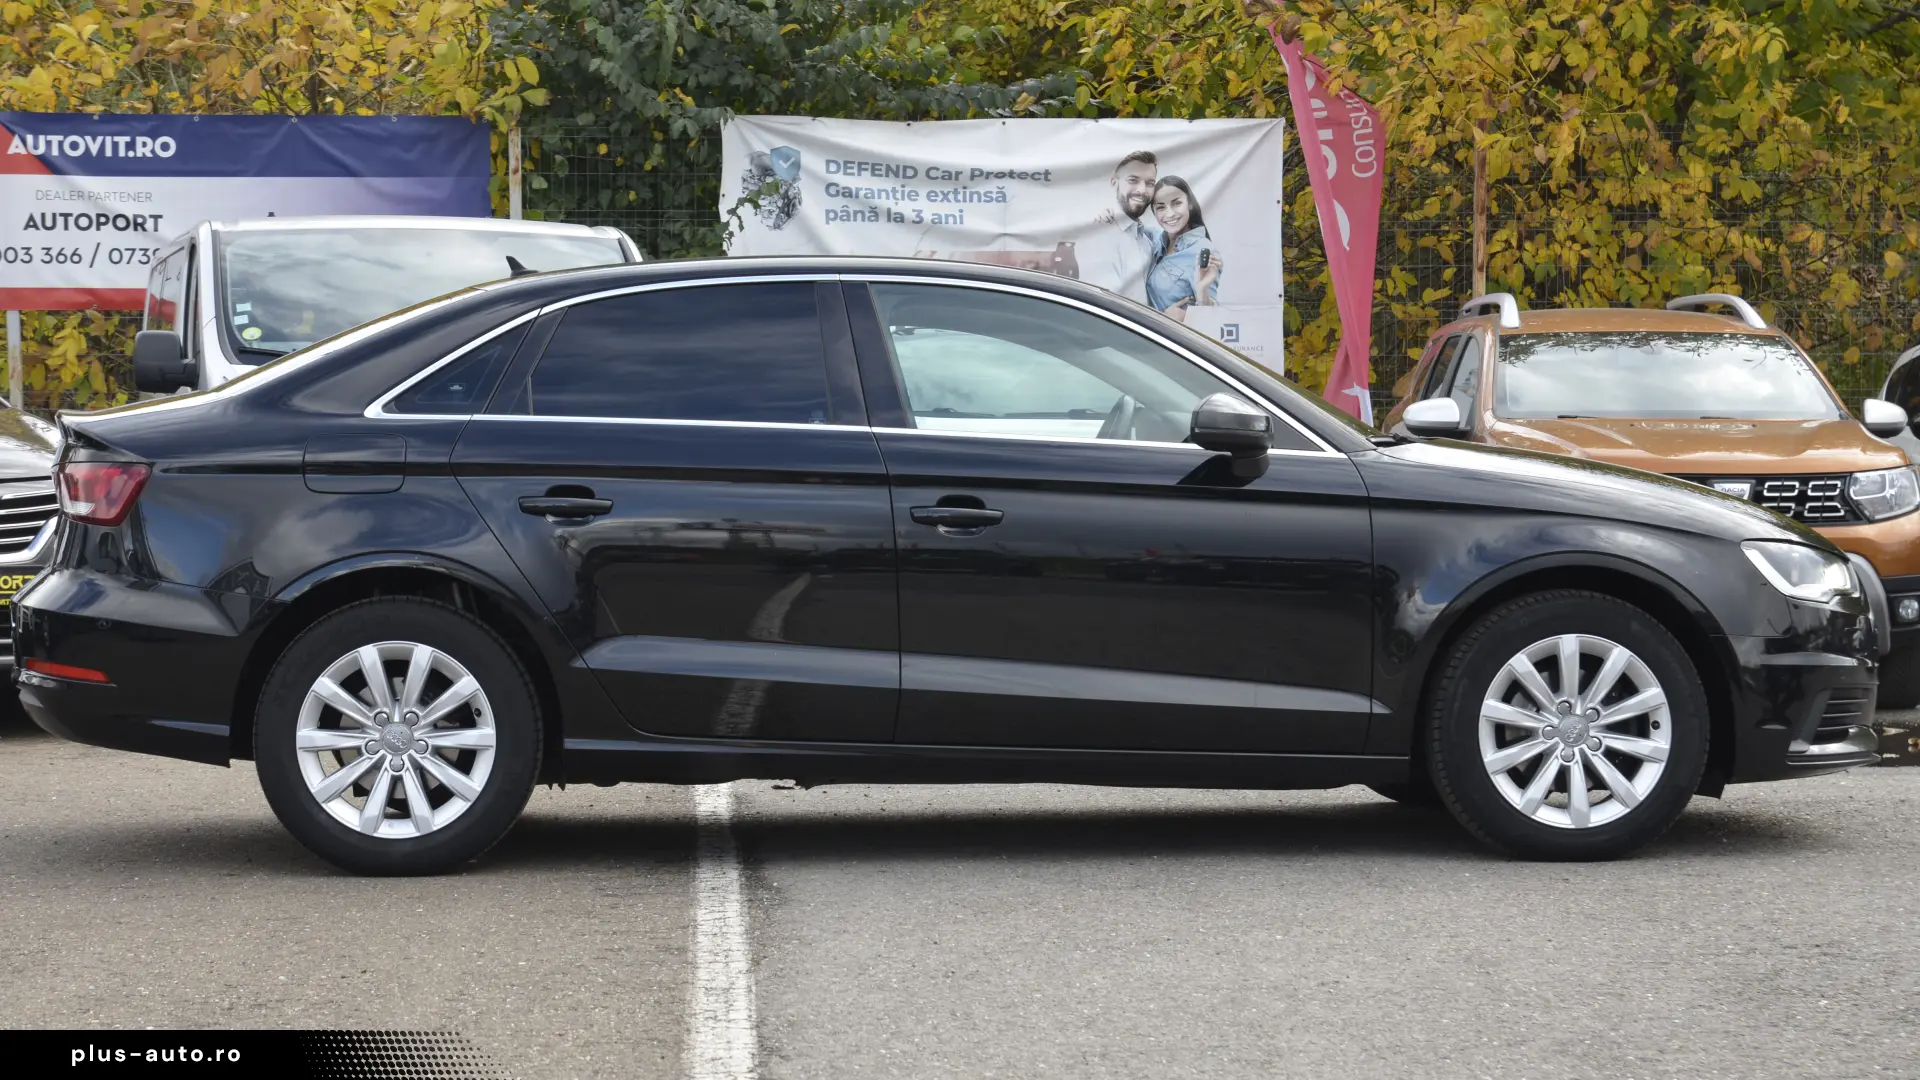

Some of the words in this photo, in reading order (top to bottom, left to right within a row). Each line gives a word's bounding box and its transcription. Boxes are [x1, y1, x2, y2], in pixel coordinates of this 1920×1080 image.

[6, 133, 177, 158] AUTOVIT.RO
[824, 158, 919, 180] DEFEND
[925, 166, 963, 181] Car
[969, 167, 1052, 182] Protect
[35, 189, 86, 202] DEALER
[88, 191, 153, 203] PARTENER
[926, 186, 1007, 204] extinsă
[23, 212, 164, 233] AUTOPORT
[824, 205, 880, 225] până
[886, 207, 905, 224] la
[911, 208, 925, 225] 3
[930, 209, 965, 225] ani
[0, 246, 34, 265] 03
[40, 246, 83, 265] 366
